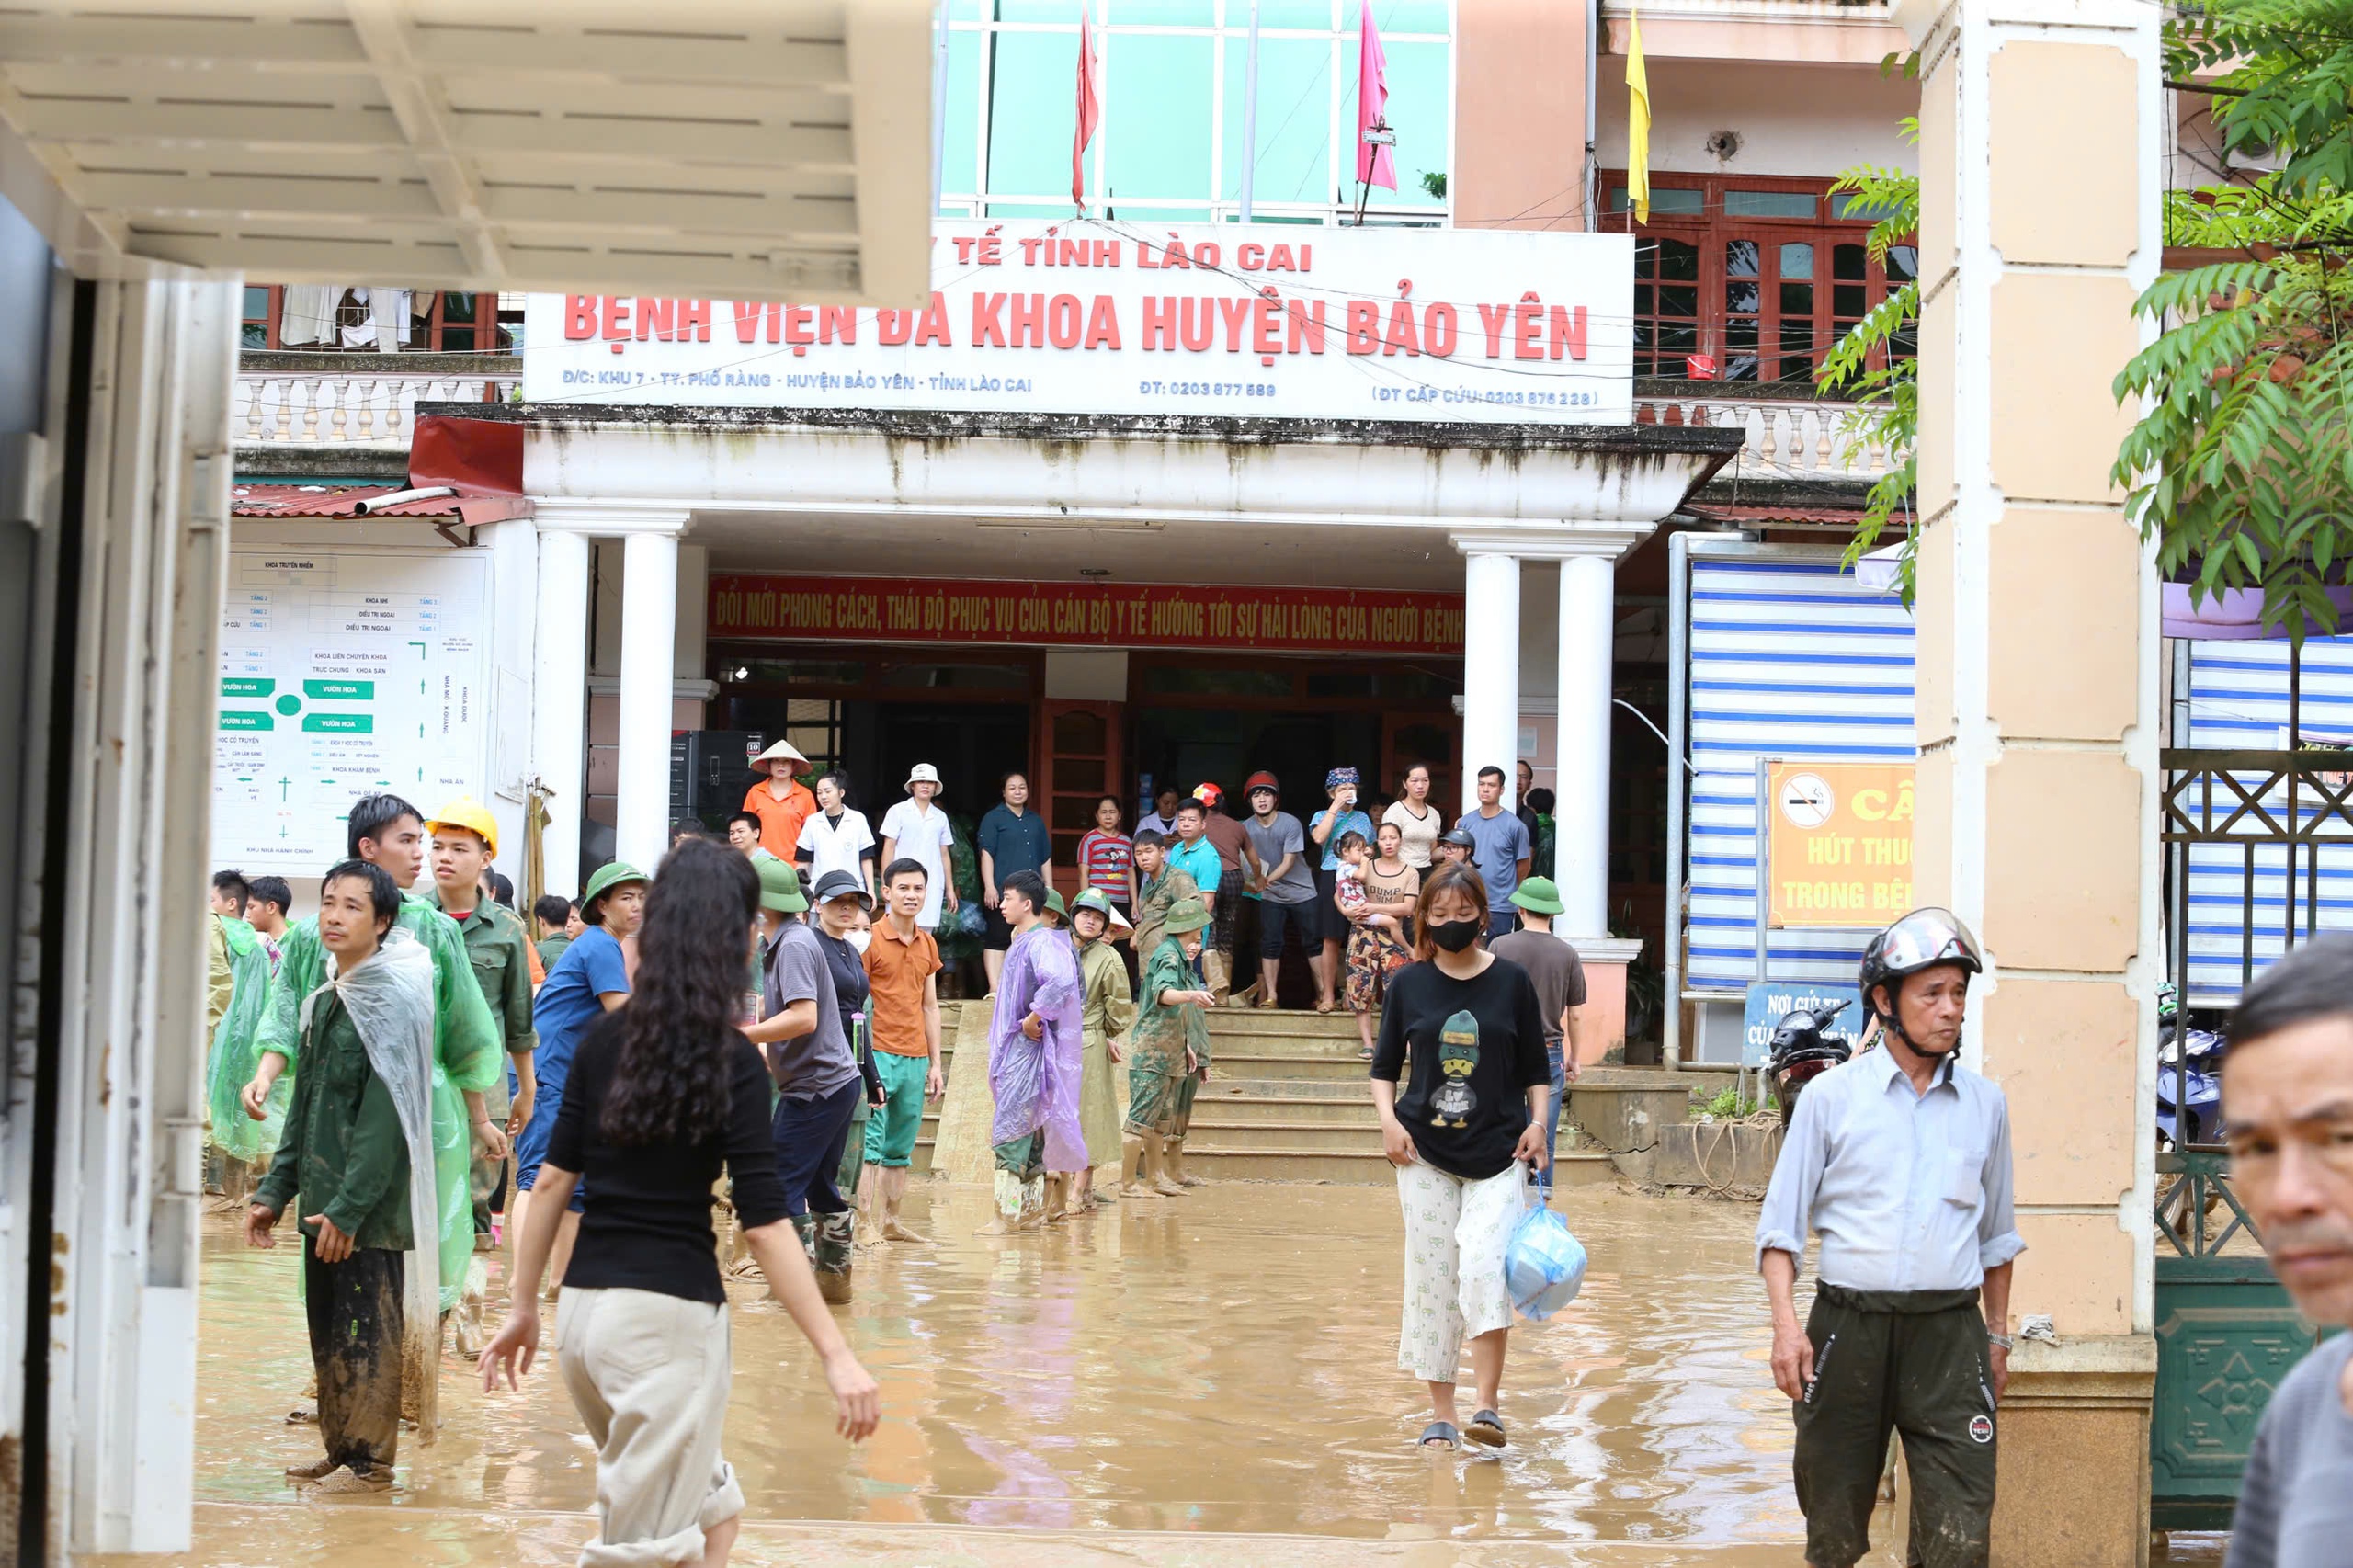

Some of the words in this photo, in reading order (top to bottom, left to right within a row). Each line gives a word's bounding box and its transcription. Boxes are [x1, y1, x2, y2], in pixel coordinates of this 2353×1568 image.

[952, 225, 1003, 265] TẾ
[1019, 226, 1120, 267] TỈNH
[1137, 232, 1221, 269] LÀO
[1237, 243, 1312, 272] CAI
[972, 292, 1122, 350] KHOA
[1142, 286, 1325, 367] HUYỆN
[1347, 278, 1458, 357] BẢO
[1477, 291, 1587, 360] YÊN
[563, 369, 595, 384] Đ/C:
[598, 371, 631, 384] KHU
[636, 372, 644, 384] 7
[661, 372, 685, 386] TT.
[688, 368, 722, 386] PHỐ
[725, 369, 770, 387] RÀNG
[787, 371, 840, 392] HUYỆN
[846, 370, 876, 389] BẢO
[882, 373, 914, 389] YÊN
[929, 372, 966, 391] TỈNH
[970, 375, 1001, 392] LÀO
[1005, 379, 1031, 392] CAI
[1140, 381, 1165, 395] ĐT:
[1170, 382, 1210, 395] 0203
[1213, 384, 1242, 396] 877
[1406, 384, 1438, 402] CẤP
[1442, 385, 1483, 403] CỨU:
[1485, 391, 1523, 403] 0203
[1528, 392, 1555, 404] 876
[717, 578, 742, 626] ĐỔI
[746, 582, 776, 627] MỚI
[780, 593, 832, 628] PHONG
[837, 586, 881, 633] CÁCH,
[886, 588, 920, 631] THÁI
[925, 588, 945, 639] ĐỘ
[949, 597, 990, 639] PHỤC
[995, 597, 1015, 640] VỤ
[1019, 583, 1050, 632] CỦA
[1054, 591, 1086, 633] CÁN
[1090, 593, 1110, 642] BỘ
[1115, 600, 1125, 635] Y
[1130, 588, 1149, 636] TẾ
[1151, 591, 1204, 637] HƯỚNG
[1209, 593, 1232, 637] TỚI
[1236, 599, 1259, 645] SỰ
[1261, 596, 1286, 639] HÀI
[1291, 596, 1331, 640] LÒNG
[1337, 592, 1367, 641] CỦA
[1371, 597, 1418, 642] NGƯỜI
[1423, 602, 1464, 651] BỆNH
[1808, 832, 1855, 864] HÚT
[1861, 837, 1913, 865] THU
[1370, 885, 1401, 895] DUMP
[1783, 881, 1865, 909] TRONG
